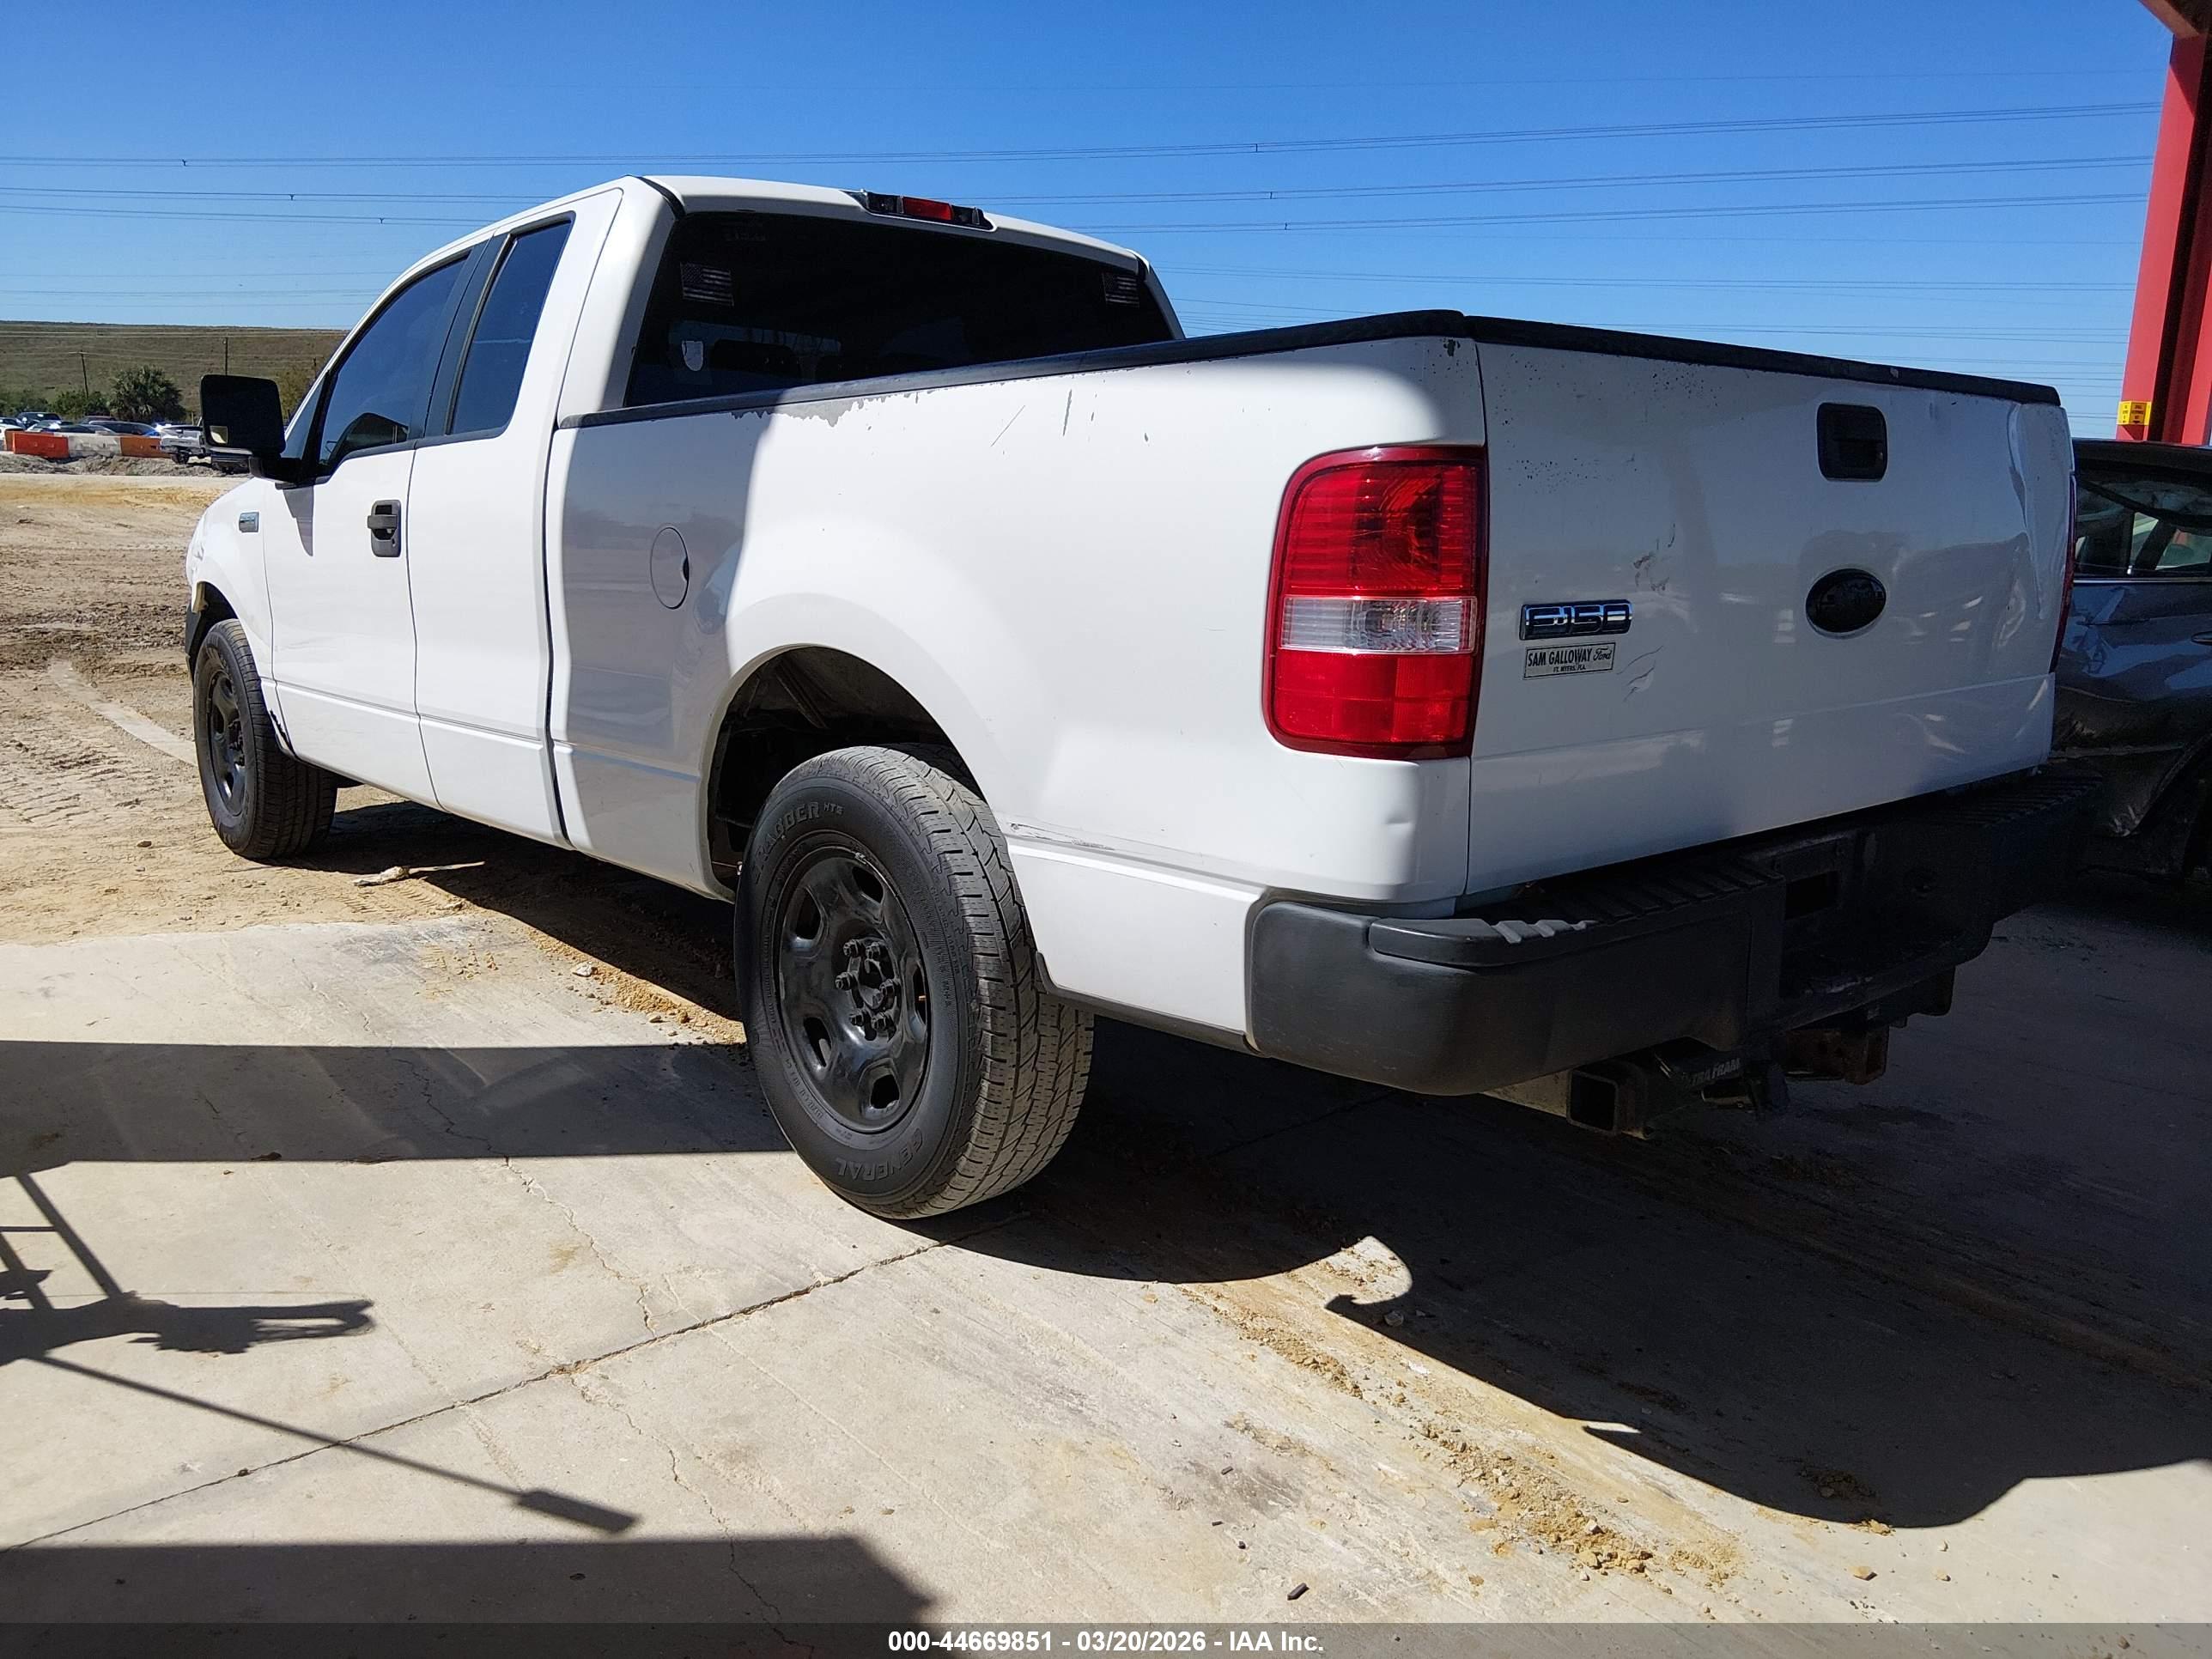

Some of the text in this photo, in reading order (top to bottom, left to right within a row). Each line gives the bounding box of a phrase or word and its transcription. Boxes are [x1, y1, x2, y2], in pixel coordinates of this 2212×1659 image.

[1528, 647, 1612, 666] SAM GALLOWAY Ford
[836, 1127, 923, 1182] GENERAL
